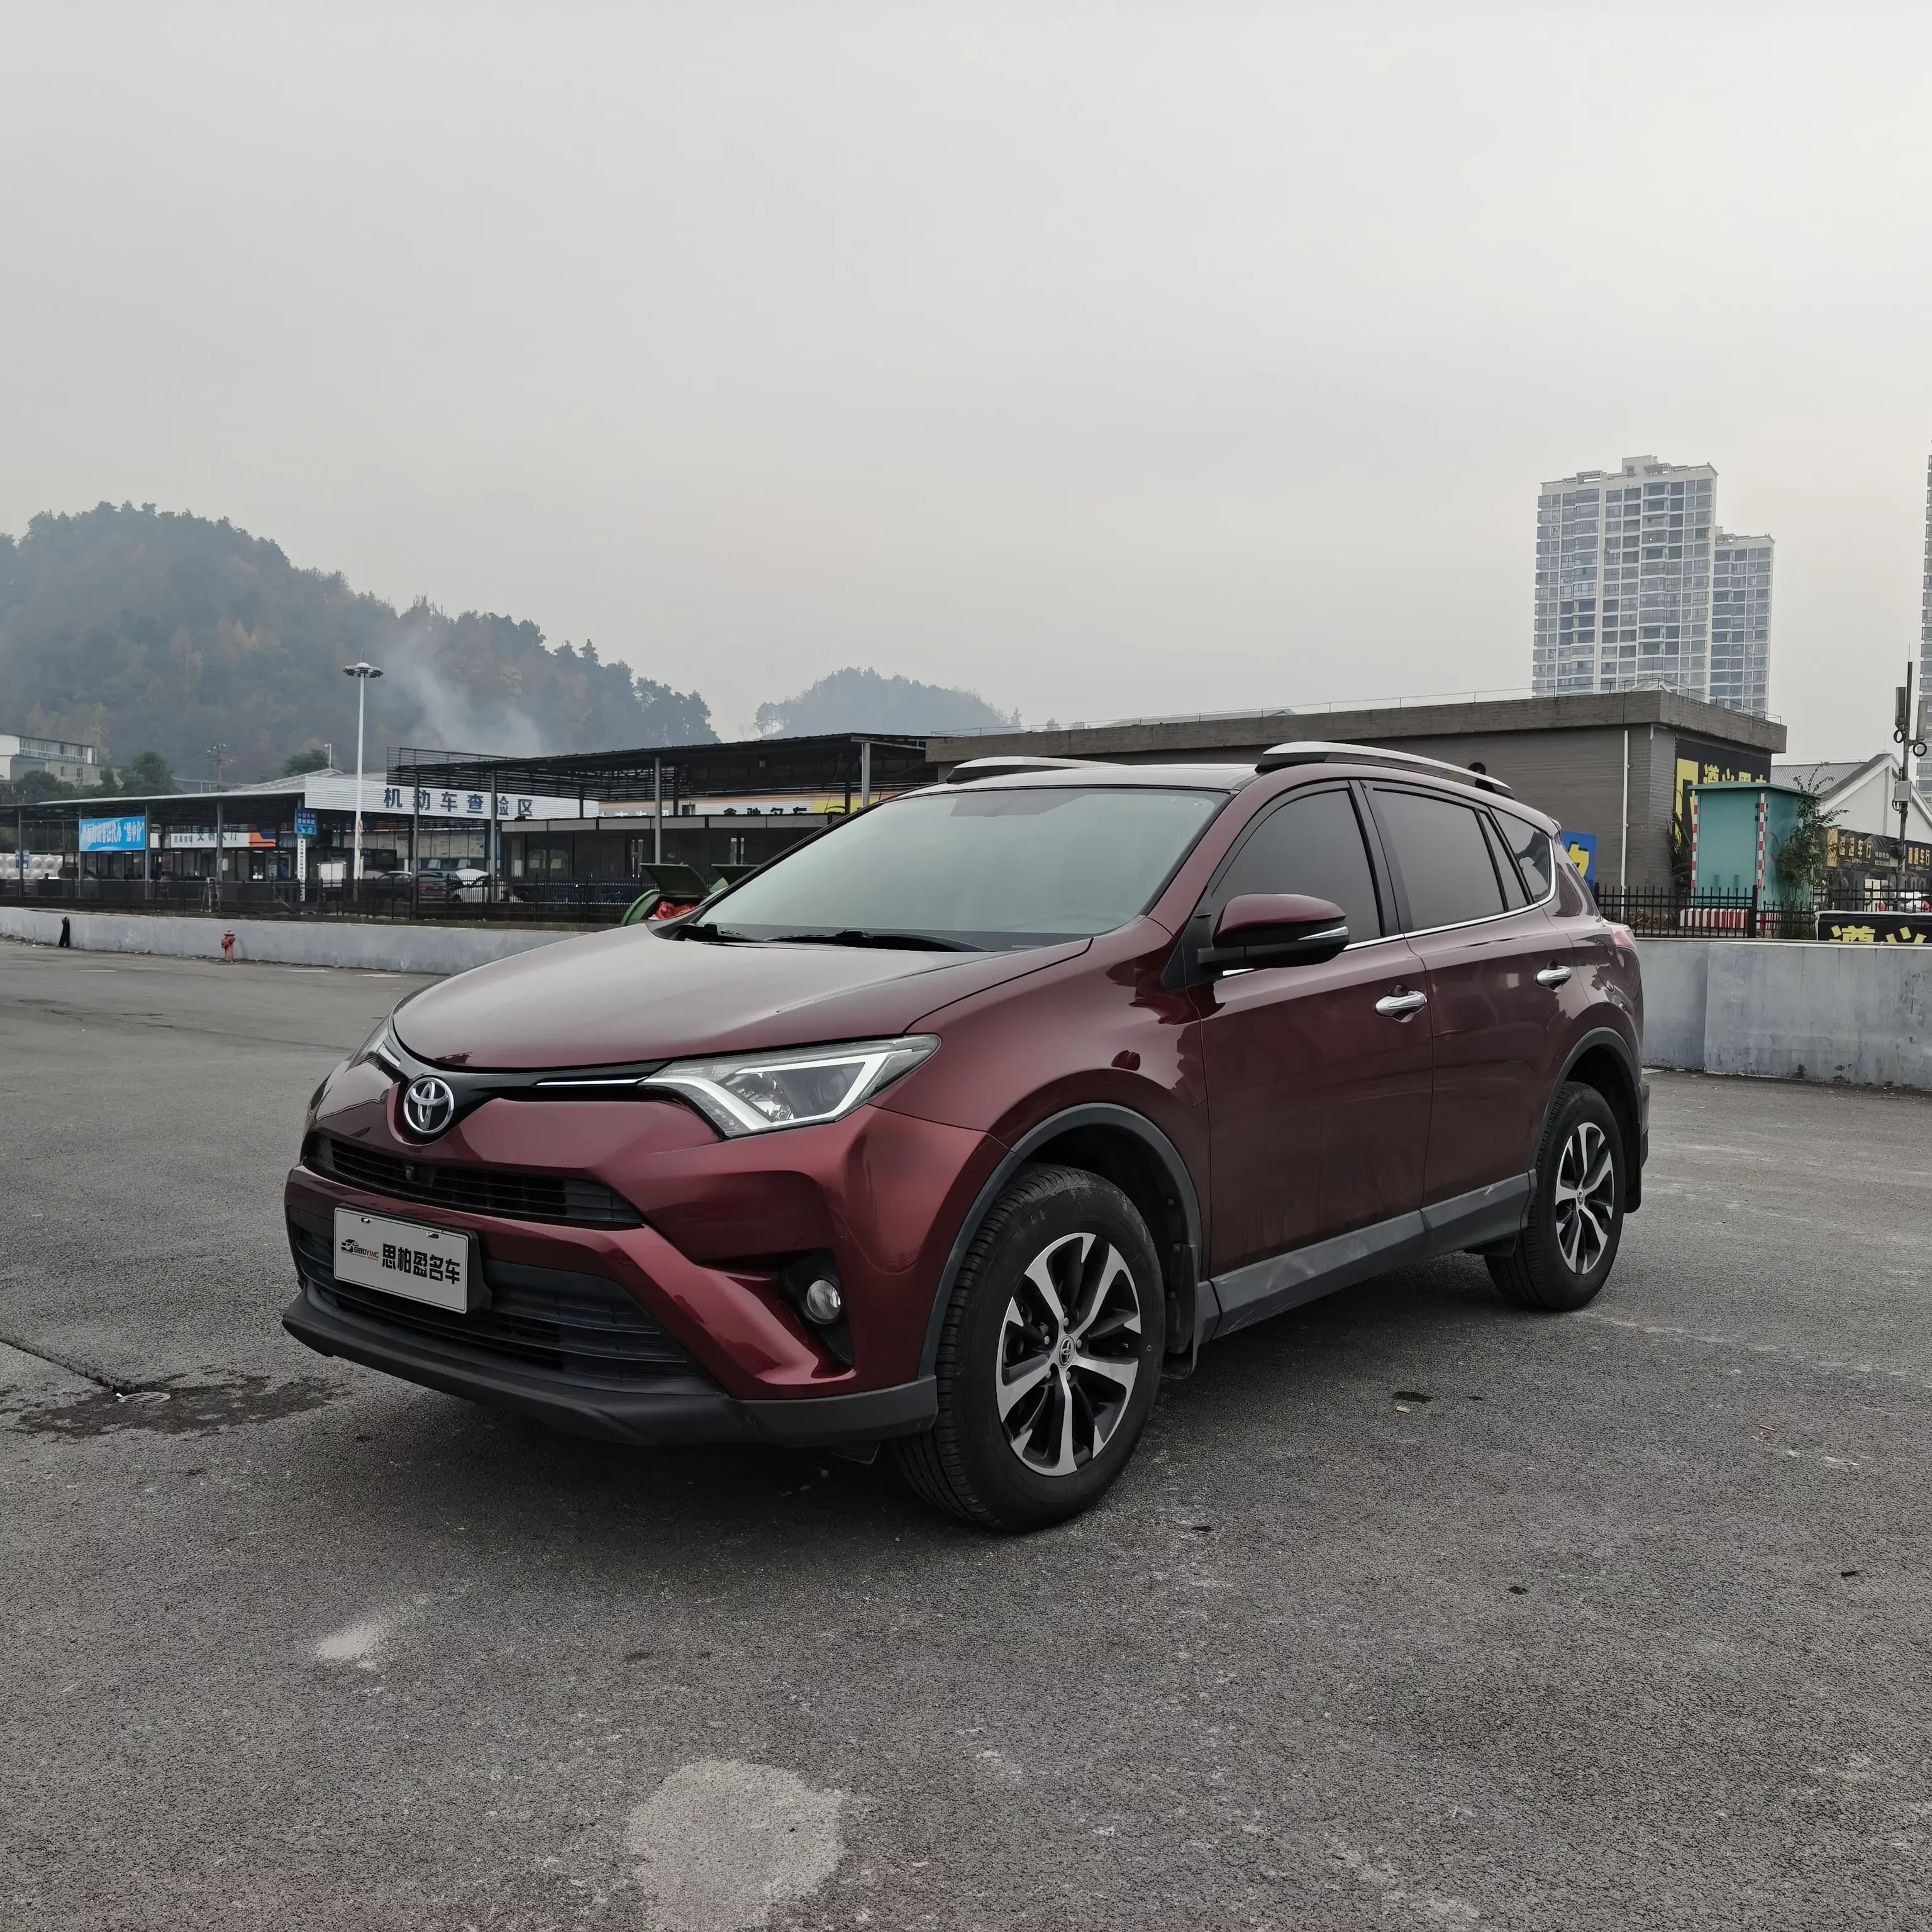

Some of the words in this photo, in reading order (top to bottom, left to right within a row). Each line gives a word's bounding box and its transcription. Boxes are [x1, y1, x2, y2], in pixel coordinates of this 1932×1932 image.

[382, 1243, 460, 1285] 思柏盈名车
